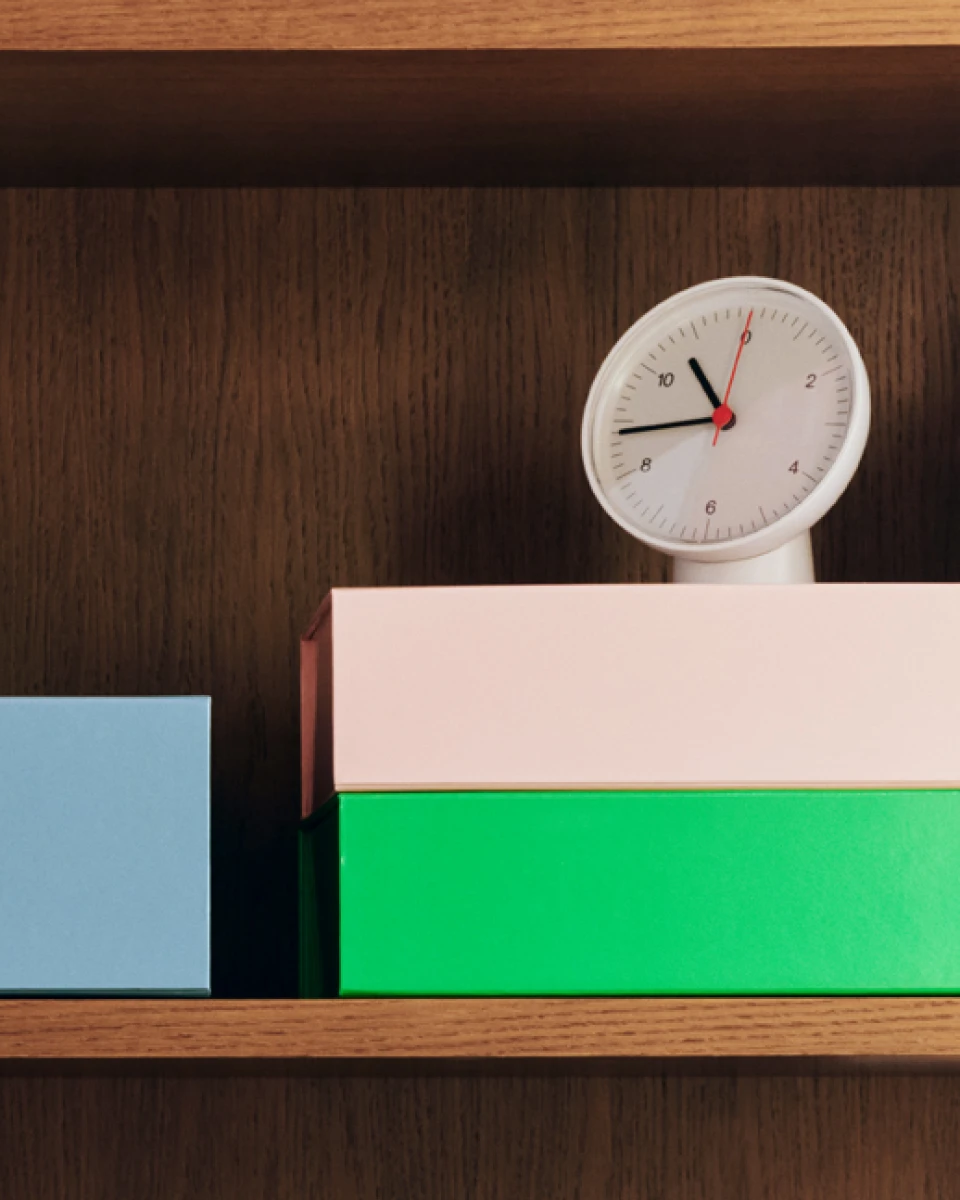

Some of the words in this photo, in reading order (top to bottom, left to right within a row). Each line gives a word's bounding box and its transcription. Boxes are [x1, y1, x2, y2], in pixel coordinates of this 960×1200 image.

[658, 372, 675, 387] 10
[805, 374, 817, 388] 2
[640, 457, 652, 472] 8
[788, 460, 799, 474] 4
[705, 500, 717, 515] 6
